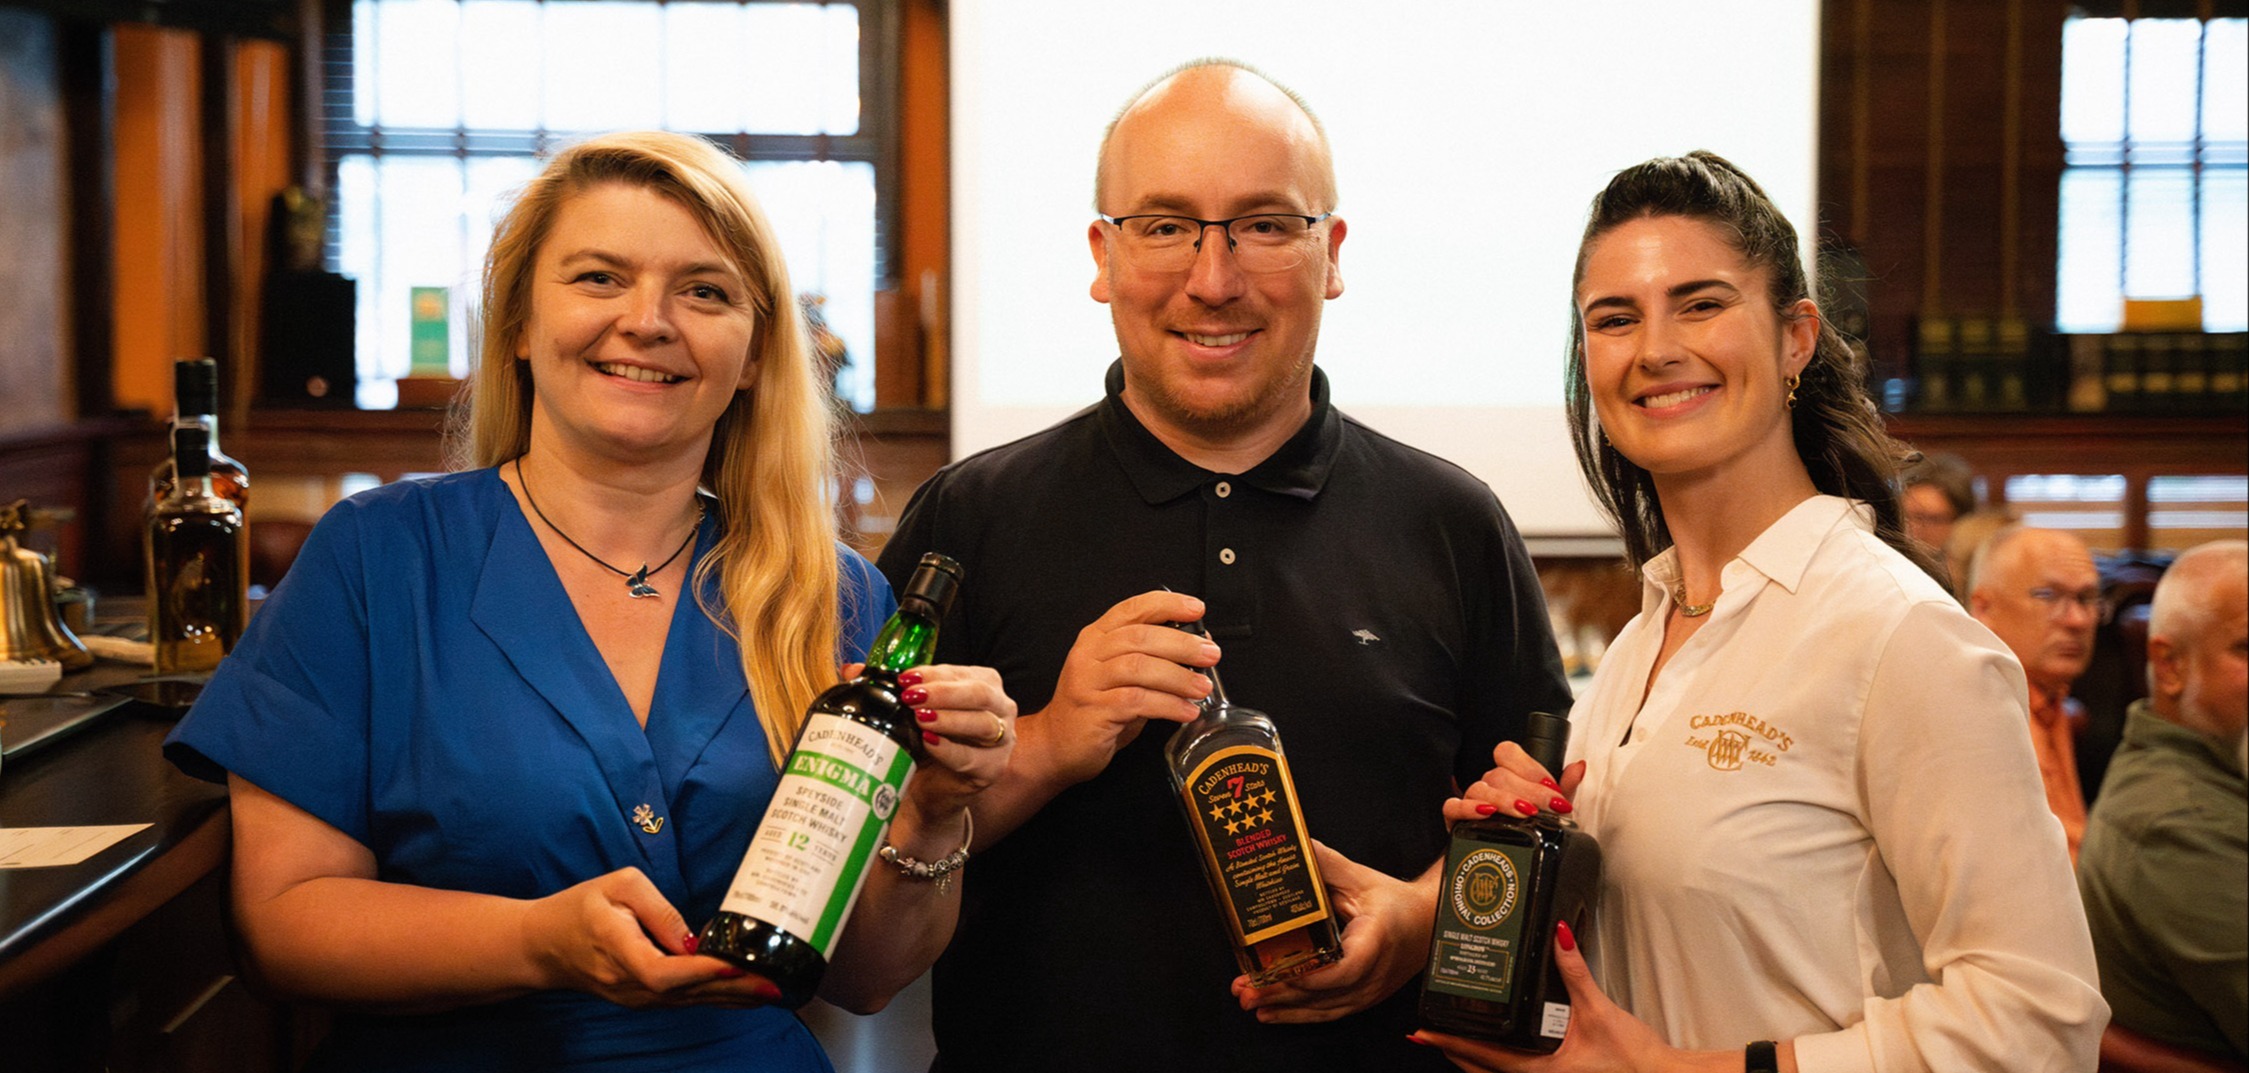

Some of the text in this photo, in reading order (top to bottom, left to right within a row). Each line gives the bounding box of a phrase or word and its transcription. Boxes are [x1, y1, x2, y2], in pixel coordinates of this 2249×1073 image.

[1690, 711, 1794, 752] CADENHEAD'S
[808, 729, 884, 766] CADENHEAD'S
[794, 755, 871, 797] ENIGMA
[1198, 762, 1269, 795] CADENHEAD'S
[1226, 775, 1245, 799] 7
[783, 797, 846, 826] SINGLE MALT
[795, 786, 844, 808] SPEYSIDE
[771, 809, 848, 843] SCOTCH WHISKY
[787, 831, 810, 852] 12
[1235, 828, 1272, 847] BLENDED
[1227, 833, 1287, 860] SCOTCH WHISKY
[1454, 875, 1516, 926] ORIGINAL COLLECTION
